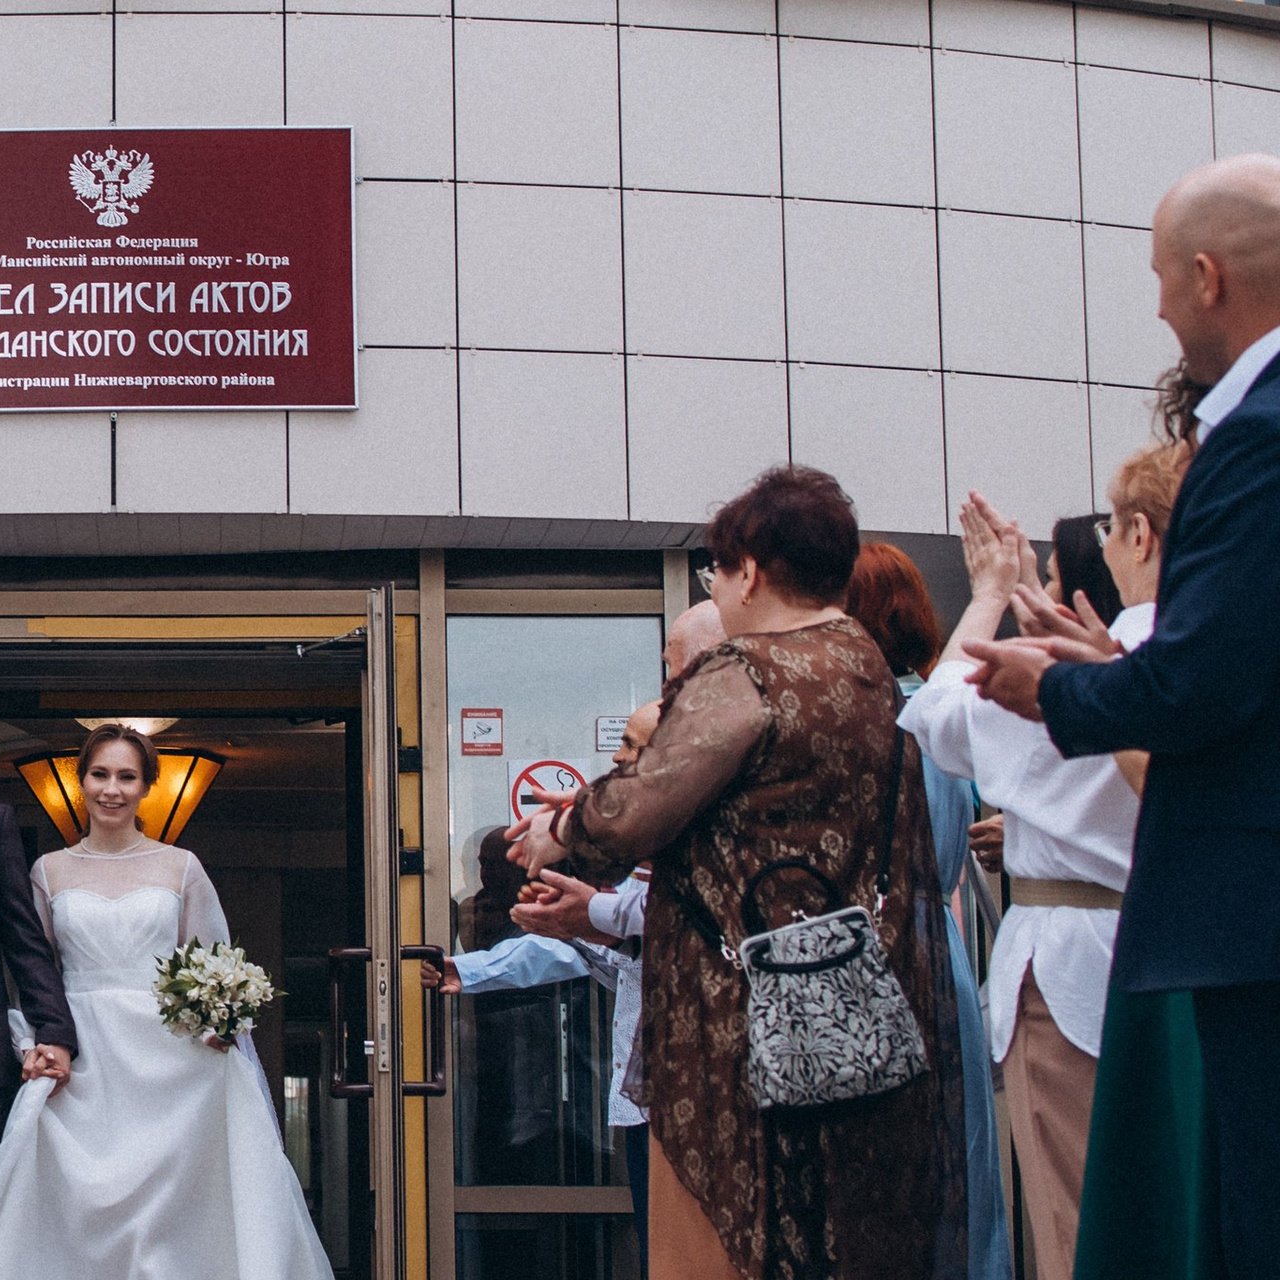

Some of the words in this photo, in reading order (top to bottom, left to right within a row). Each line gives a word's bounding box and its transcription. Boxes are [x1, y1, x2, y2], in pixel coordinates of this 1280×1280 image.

[26, 235, 111, 250] Российская
[116, 235, 199, 252] Федерация
[91, 253, 186, 268] автономный
[189, 255, 233, 270] округ
[246, 252, 290, 270] Югра
[47, 282, 177, 315] ЗАПИСИ
[189, 281, 293, 314] АКТОВ
[147, 328, 309, 358] СОСТОЯНИЯ
[74, 373, 218, 389] Нижневартовского
[221, 373, 276, 389] района
